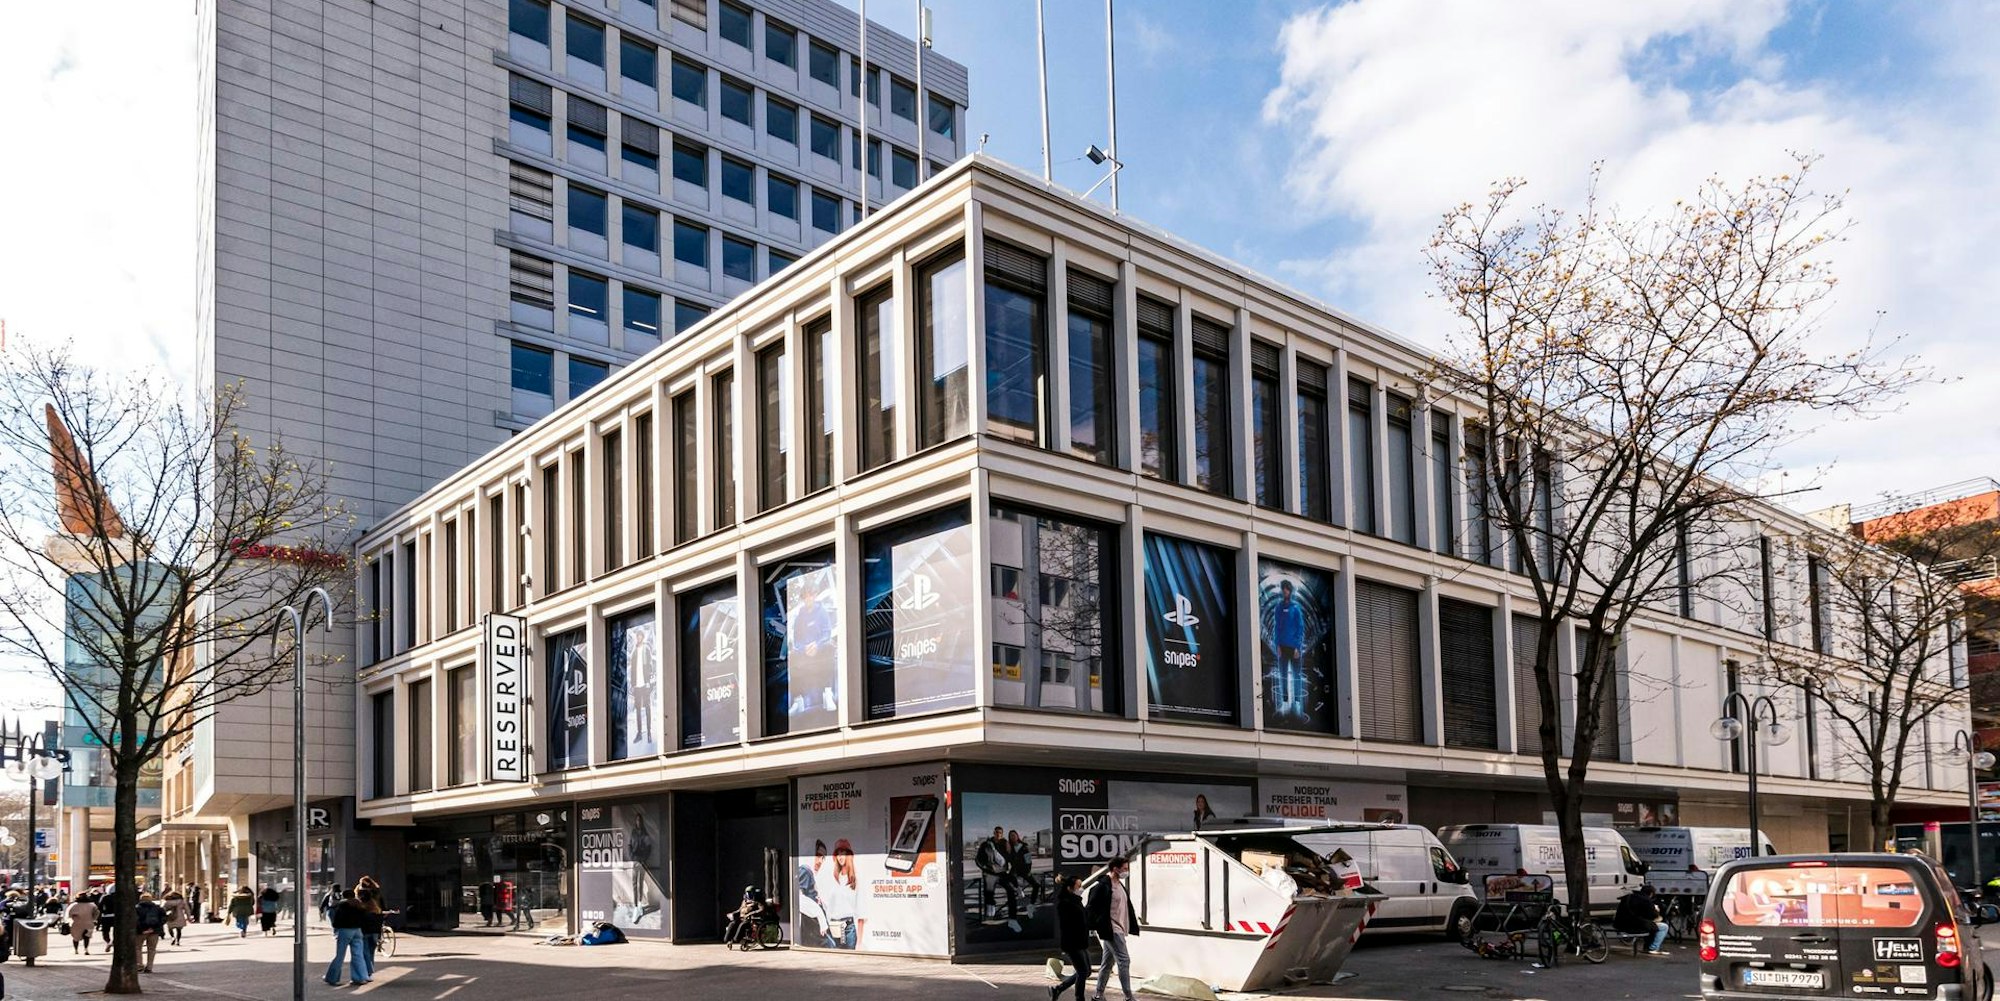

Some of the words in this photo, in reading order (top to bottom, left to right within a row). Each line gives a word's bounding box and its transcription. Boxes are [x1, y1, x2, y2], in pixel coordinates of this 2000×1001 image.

[900, 638, 936, 659] snipes
[1164, 650, 1197, 668] snipes
[496, 624, 516, 771] RESERVED
[707, 685, 732, 702] snipes
[567, 713, 586, 728] snipes
[823, 781, 856, 791] NOBODY
[912, 775, 937, 786] snipes
[1059, 778, 1096, 795] snipes
[805, 790, 838, 802] FRESHER
[841, 789, 861, 799] THAN
[1294, 785, 1330, 796] NOBODY
[813, 800, 850, 812] CLIQUE
[1271, 795, 1312, 805] FRESHER
[1314, 796, 1337, 806] THAN
[1266, 804, 1280, 813] MY
[1281, 805, 1325, 817] CLIQUE
[1060, 814, 1139, 831] COMING
[582, 832, 624, 849] COMING
[1060, 834, 1139, 858] SOON
[582, 848, 624, 868] SOON
[1150, 853, 1192, 864] REMONDIS
[1734, 846, 1751, 858] BOT
[874, 885, 903, 893] SNIPES
[906, 885, 922, 893] APP
[1877, 941, 1919, 958] HELM
[1753, 972, 1767, 982] SU
[1792, 974, 1820, 984] 7979
